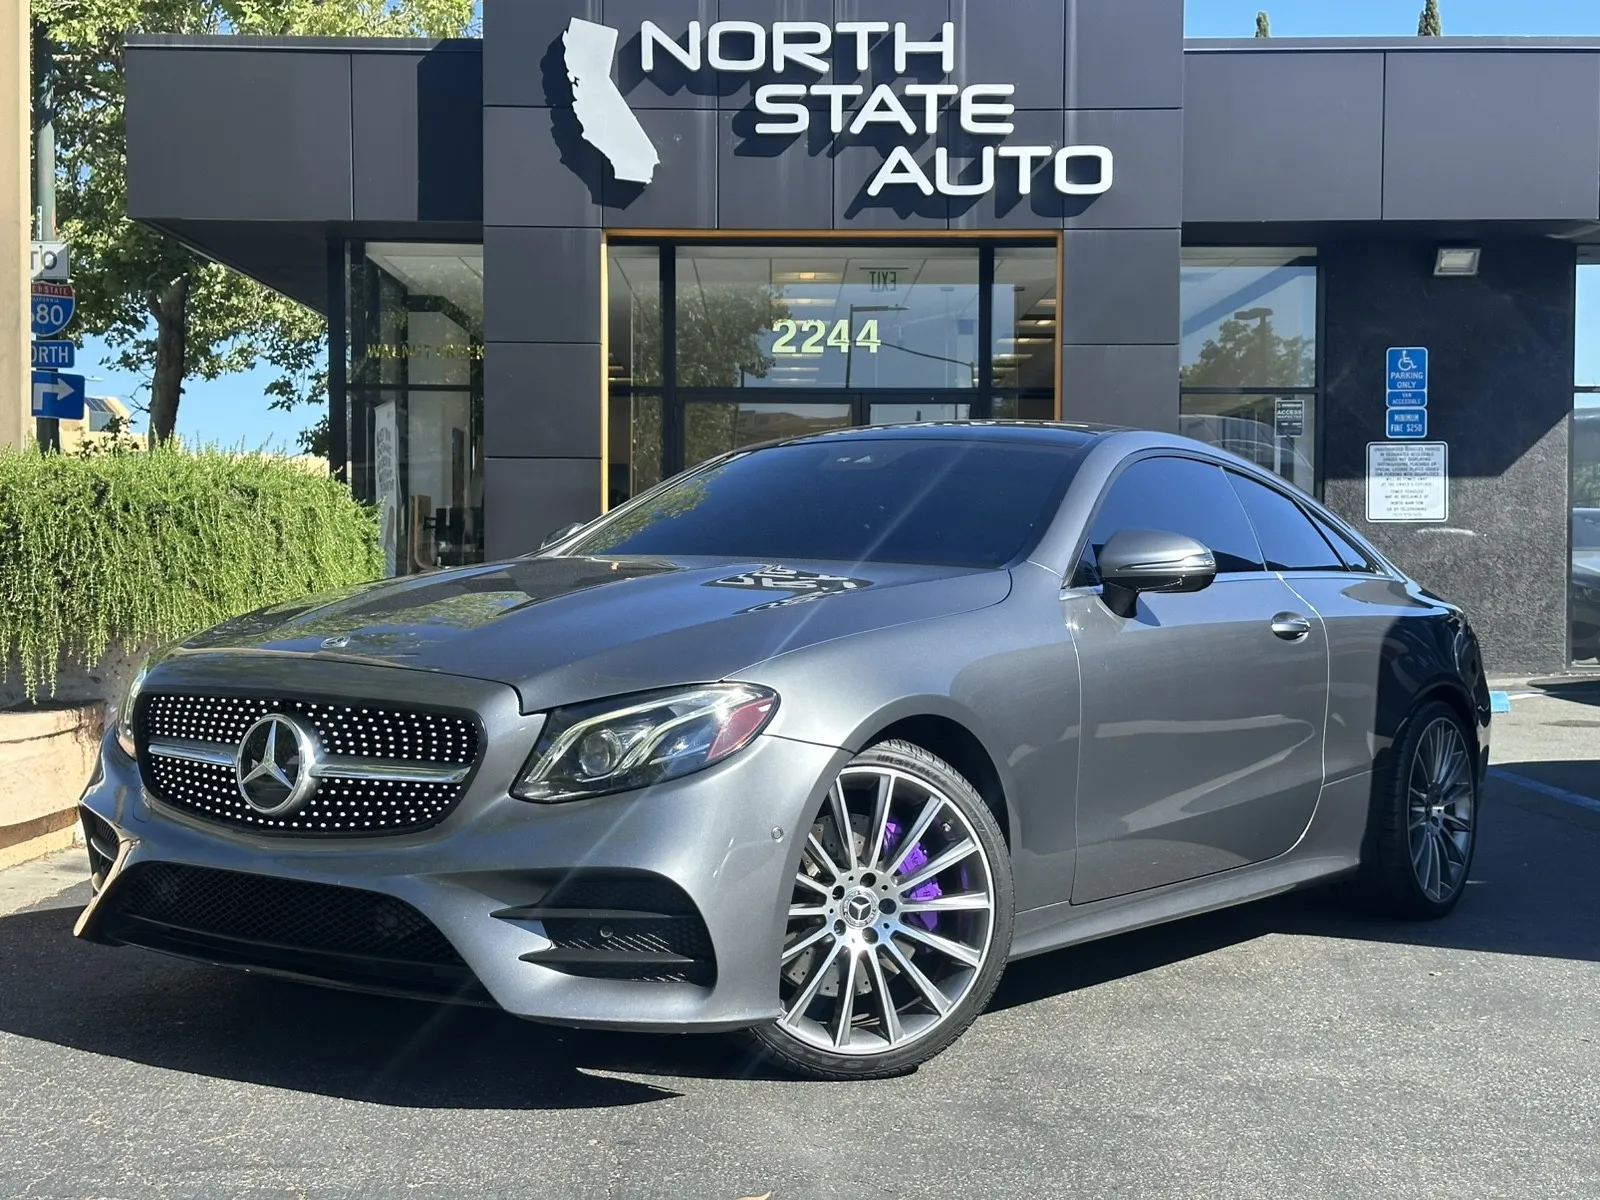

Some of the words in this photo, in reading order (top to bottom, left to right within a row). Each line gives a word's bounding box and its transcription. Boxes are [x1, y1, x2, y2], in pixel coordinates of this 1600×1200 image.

[641, 20, 955, 73] NORTH
[754, 83, 1015, 135] STATE
[867, 145, 1114, 196] AUTO
[32, 285, 68, 295] ERSTATE
[31, 303, 63, 326] 80
[771, 319, 882, 354] 2244
[31, 345, 69, 363] ORTH
[1390, 371, 1424, 380] PARKING
[1396, 381, 1417, 389] ONLY
[1394, 414, 1419, 422] MINIMUM
[1391, 423, 1404, 432] FINE
[1406, 423, 1423, 432] $250
